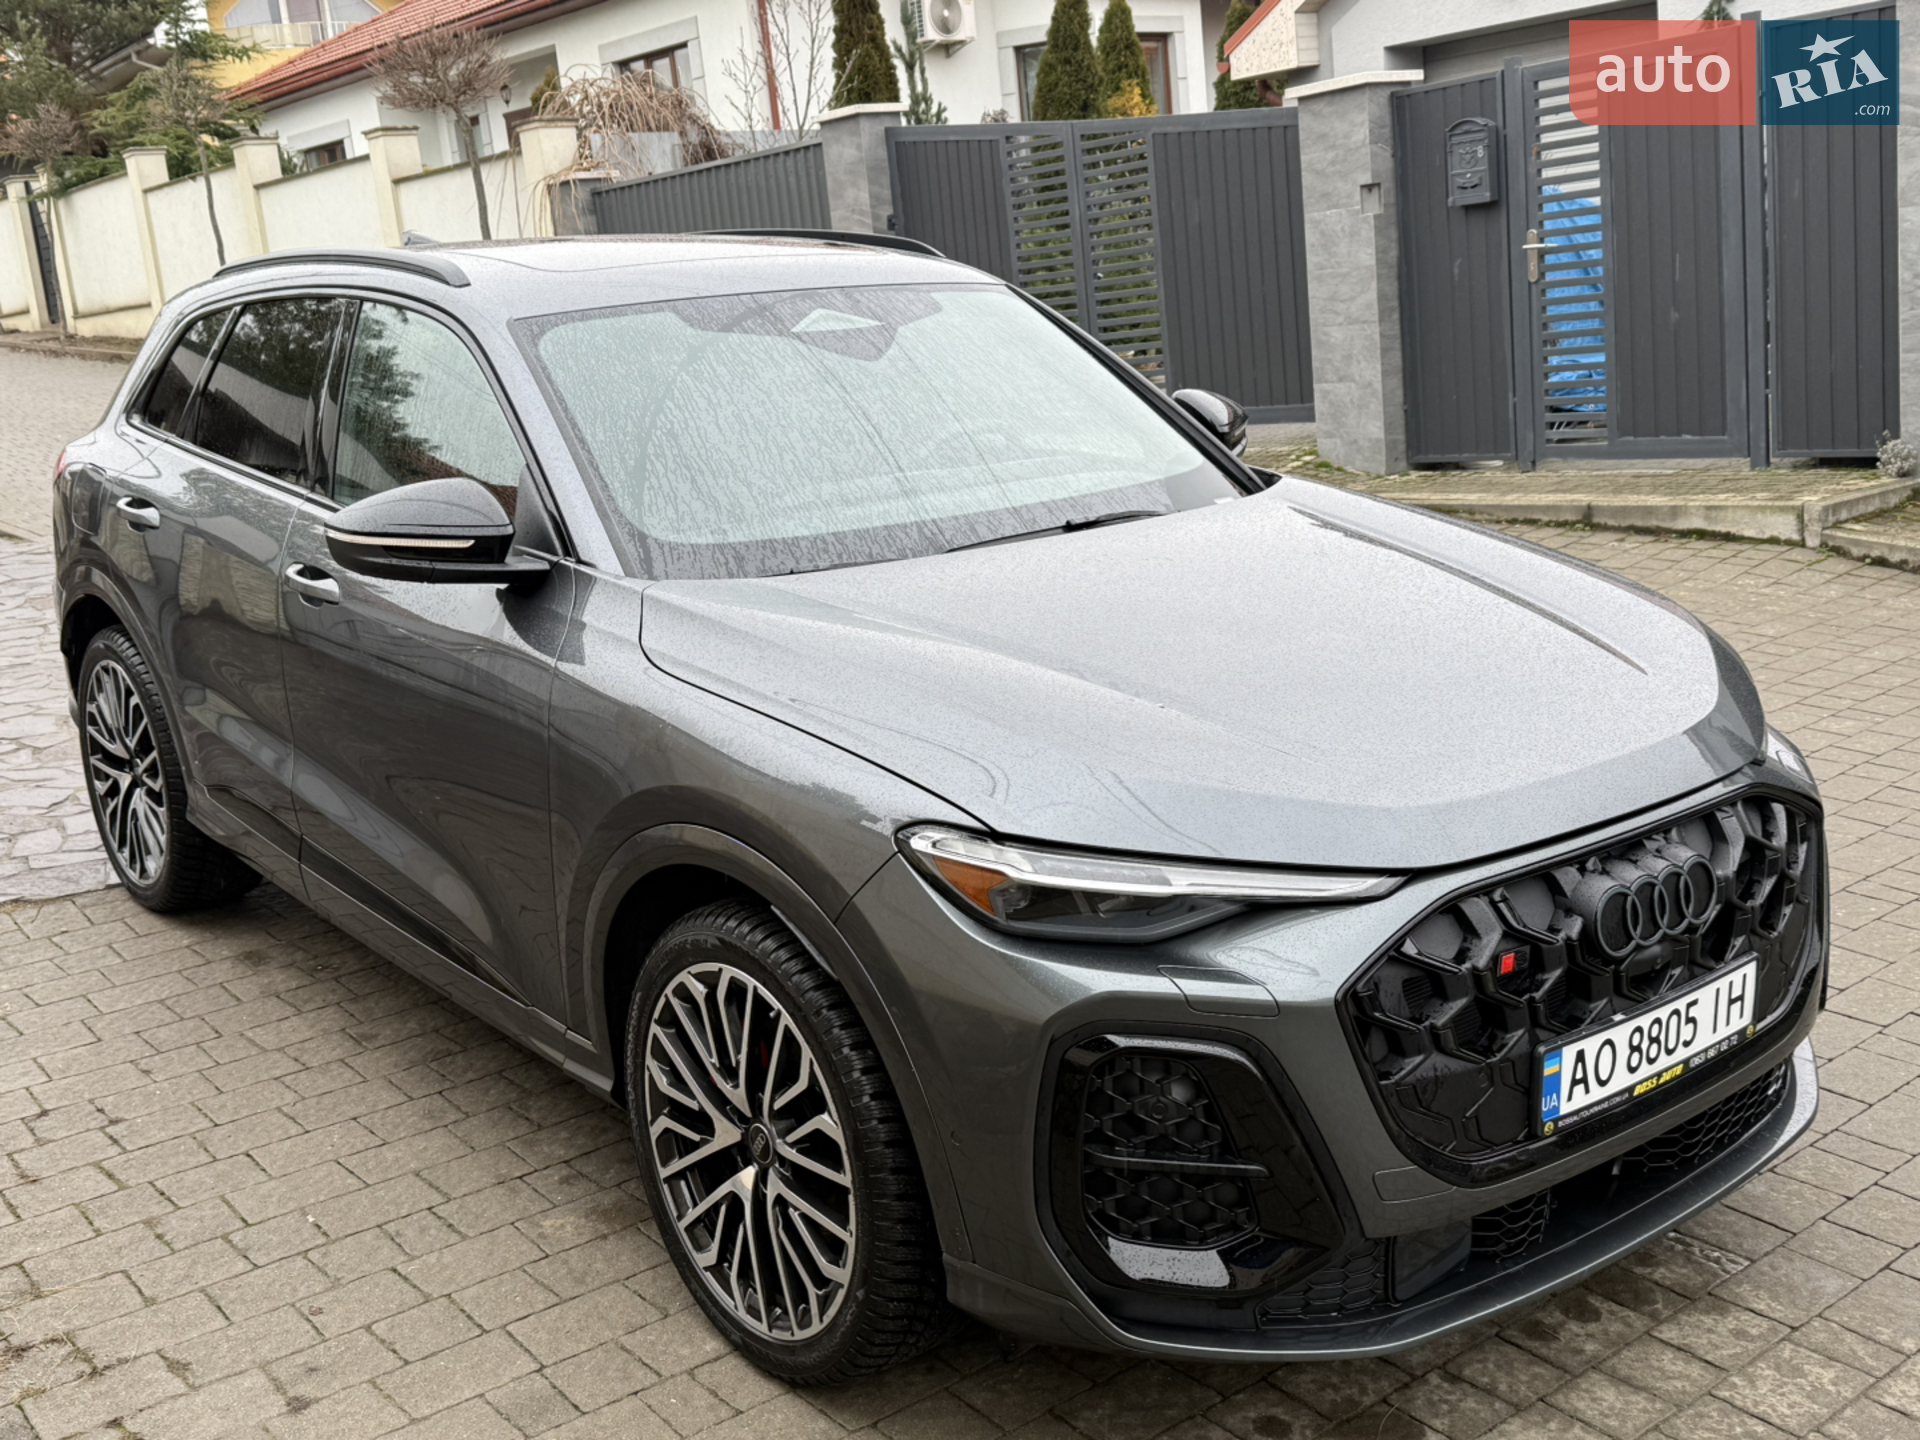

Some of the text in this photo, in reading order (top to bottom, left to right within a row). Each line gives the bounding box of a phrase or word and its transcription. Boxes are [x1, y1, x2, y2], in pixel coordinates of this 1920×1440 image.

[1566, 972, 1747, 1103] AO 8805 IH
[1633, 1076, 1658, 1096] BOSS
[1658, 1064, 1684, 1084] AUTO
[1541, 1092, 1559, 1112] UA
